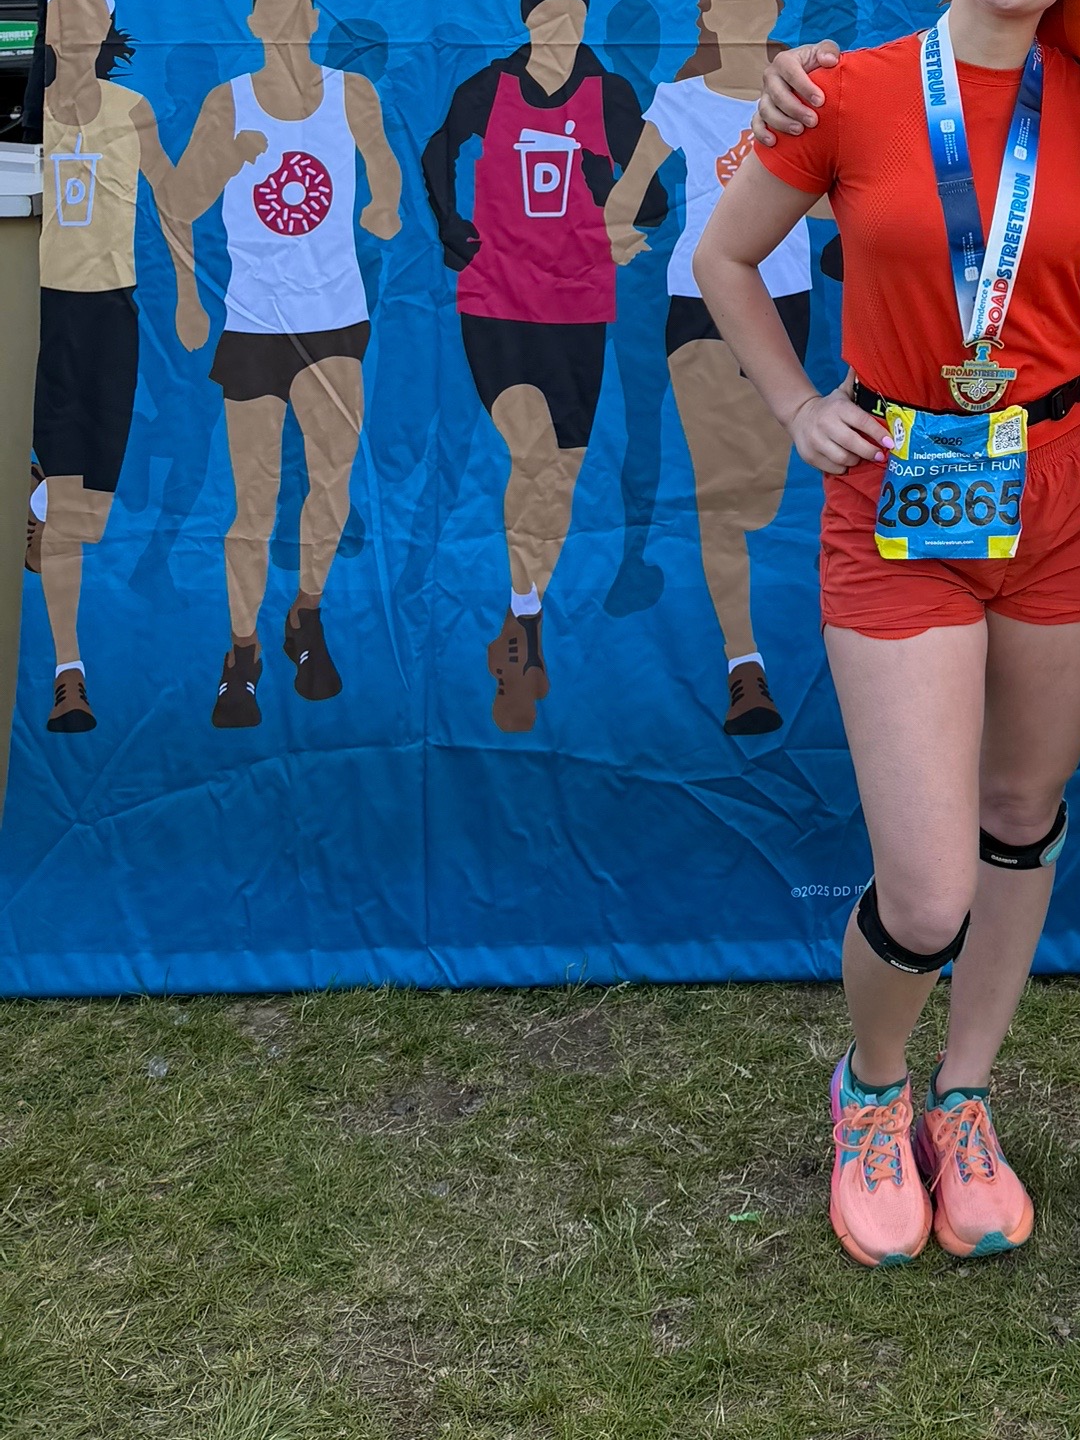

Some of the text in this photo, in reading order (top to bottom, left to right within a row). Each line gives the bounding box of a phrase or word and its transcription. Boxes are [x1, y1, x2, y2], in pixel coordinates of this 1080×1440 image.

[533, 162, 561, 193] D
[934, 436, 963, 446] 2026
[929, 461, 985, 476] STREET
[991, 458, 1021, 472] RUN
[877, 480, 1021, 528] 28865
[833, 886, 851, 897] DD
